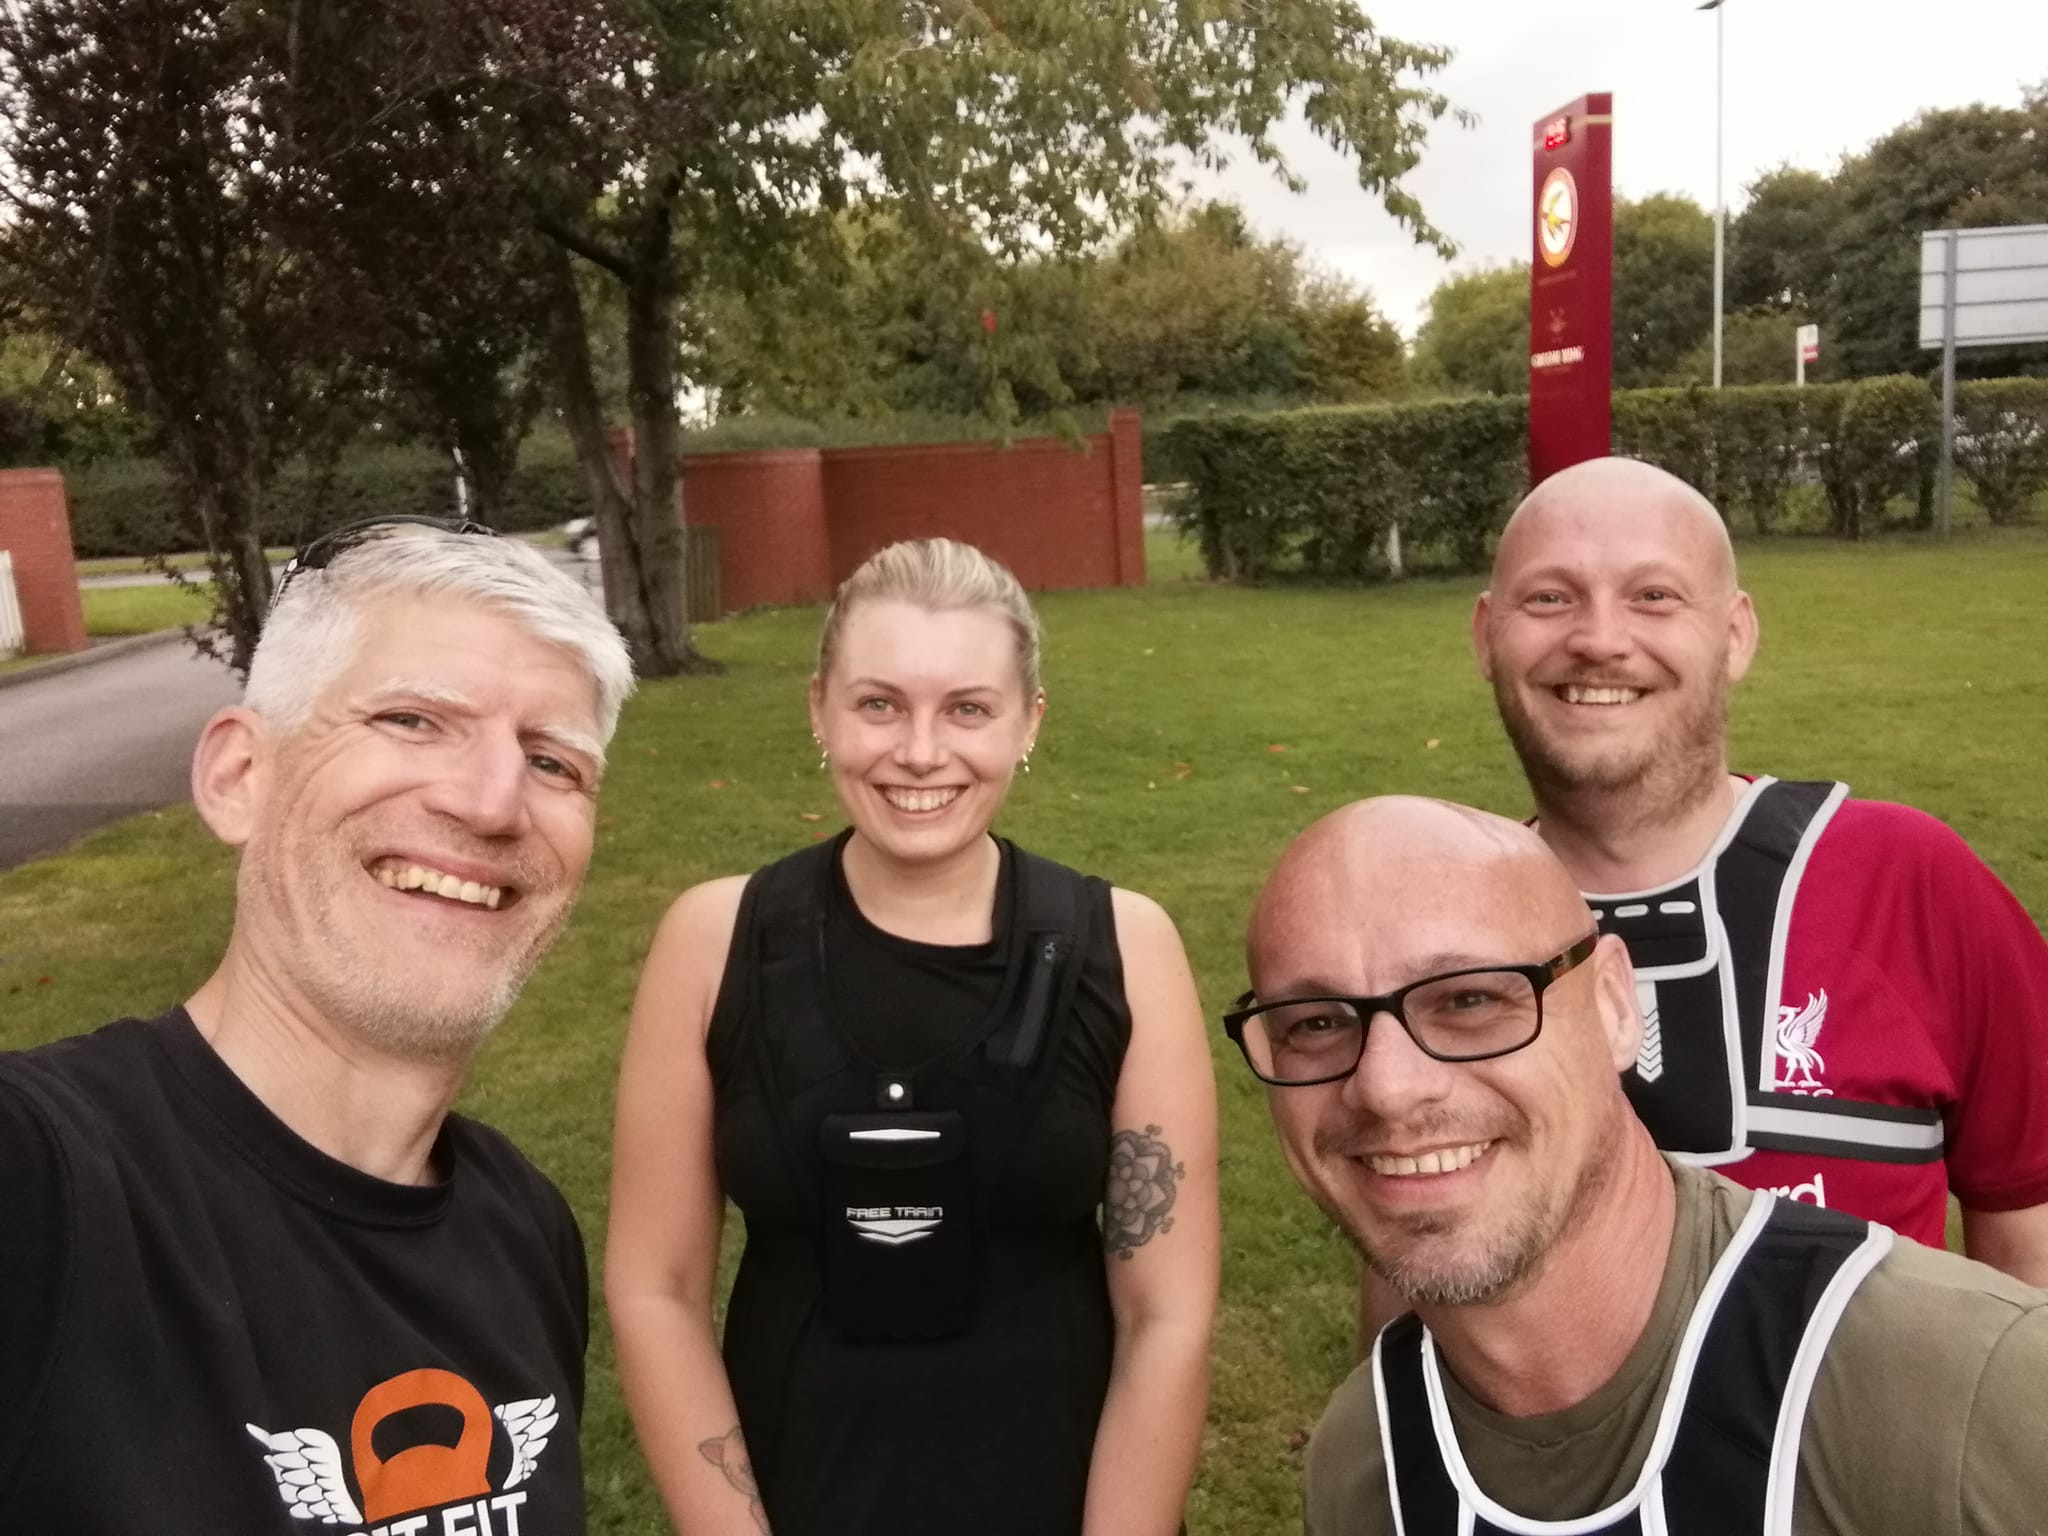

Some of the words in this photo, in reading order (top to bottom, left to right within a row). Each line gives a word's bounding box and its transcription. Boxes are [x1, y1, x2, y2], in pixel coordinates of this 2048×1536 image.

[846, 1207, 892, 1219] FREE
[894, 1206, 943, 1217] TRAIN
[442, 1491, 527, 1536] FIT
